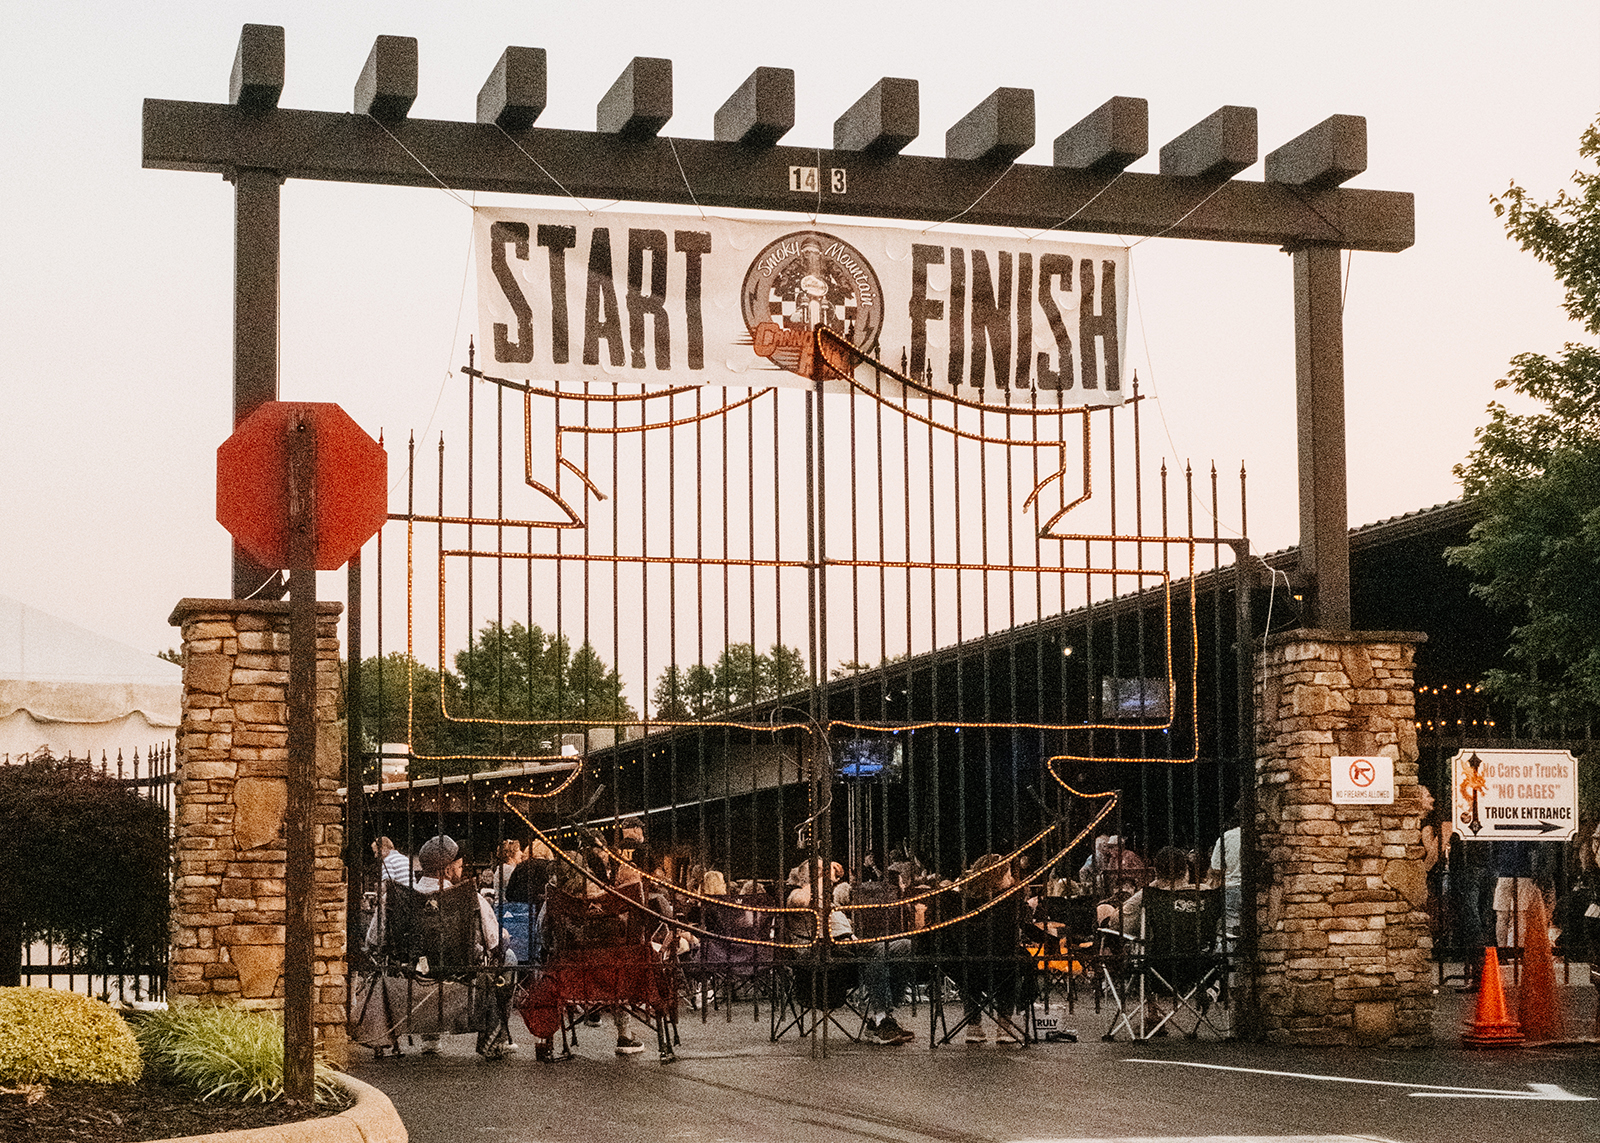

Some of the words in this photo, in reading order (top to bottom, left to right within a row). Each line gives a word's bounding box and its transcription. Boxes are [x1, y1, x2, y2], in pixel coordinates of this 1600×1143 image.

[833, 169, 845, 193] 3
[757, 240, 801, 277] Smoky
[824, 242, 876, 308] Mountain
[489, 221, 712, 371] START
[908, 242, 1121, 392] FINISH
[1483, 762, 1496, 778] No
[1497, 763, 1521, 779] Cars
[1523, 766, 1533, 779] or
[1535, 763, 1569, 779] Trucks
[1335, 790, 1343, 799] NO
[1344, 790, 1368, 799] FIREARMS
[1368, 790, 1390, 799] ALLOWED
[1492, 783, 1515, 799] "NO
[1517, 783, 1561, 800] CAGES"
[1485, 806, 1519, 820] TRUCK
[1521, 806, 1571, 820] ENTRANCE
